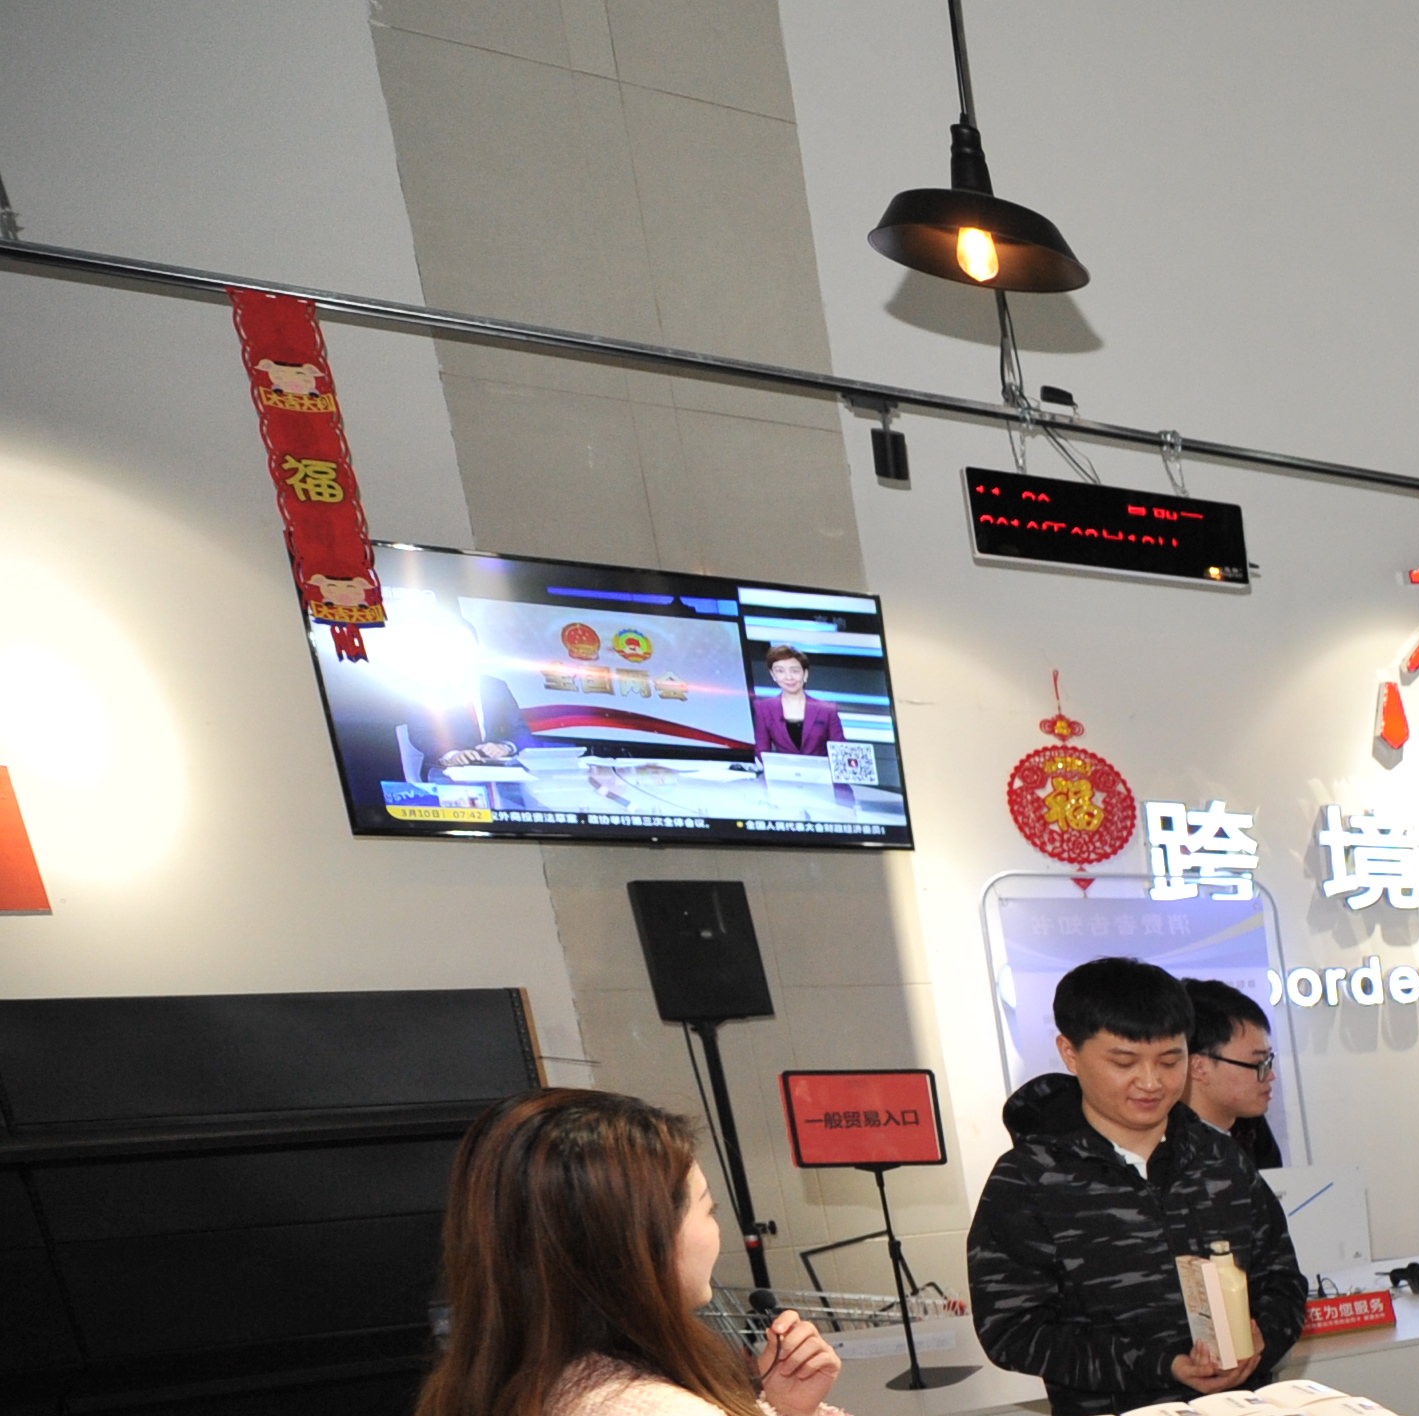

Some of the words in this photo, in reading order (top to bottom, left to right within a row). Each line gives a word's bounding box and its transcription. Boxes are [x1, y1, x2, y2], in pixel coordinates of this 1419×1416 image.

[265, 392, 334, 412] 大吉大利
[282, 455, 344, 503] 福
[542, 665, 689, 701] 全国两会
[453, 810, 482, 819] 07:42
[1045, 777, 1104, 831] 福
[745, 820, 885, 835] 全国人民代表大会财政经济委员
[804, 1109, 920, 1129] 一般贸易入口
[1305, 1298, 1384, 1322] 在为您服务
